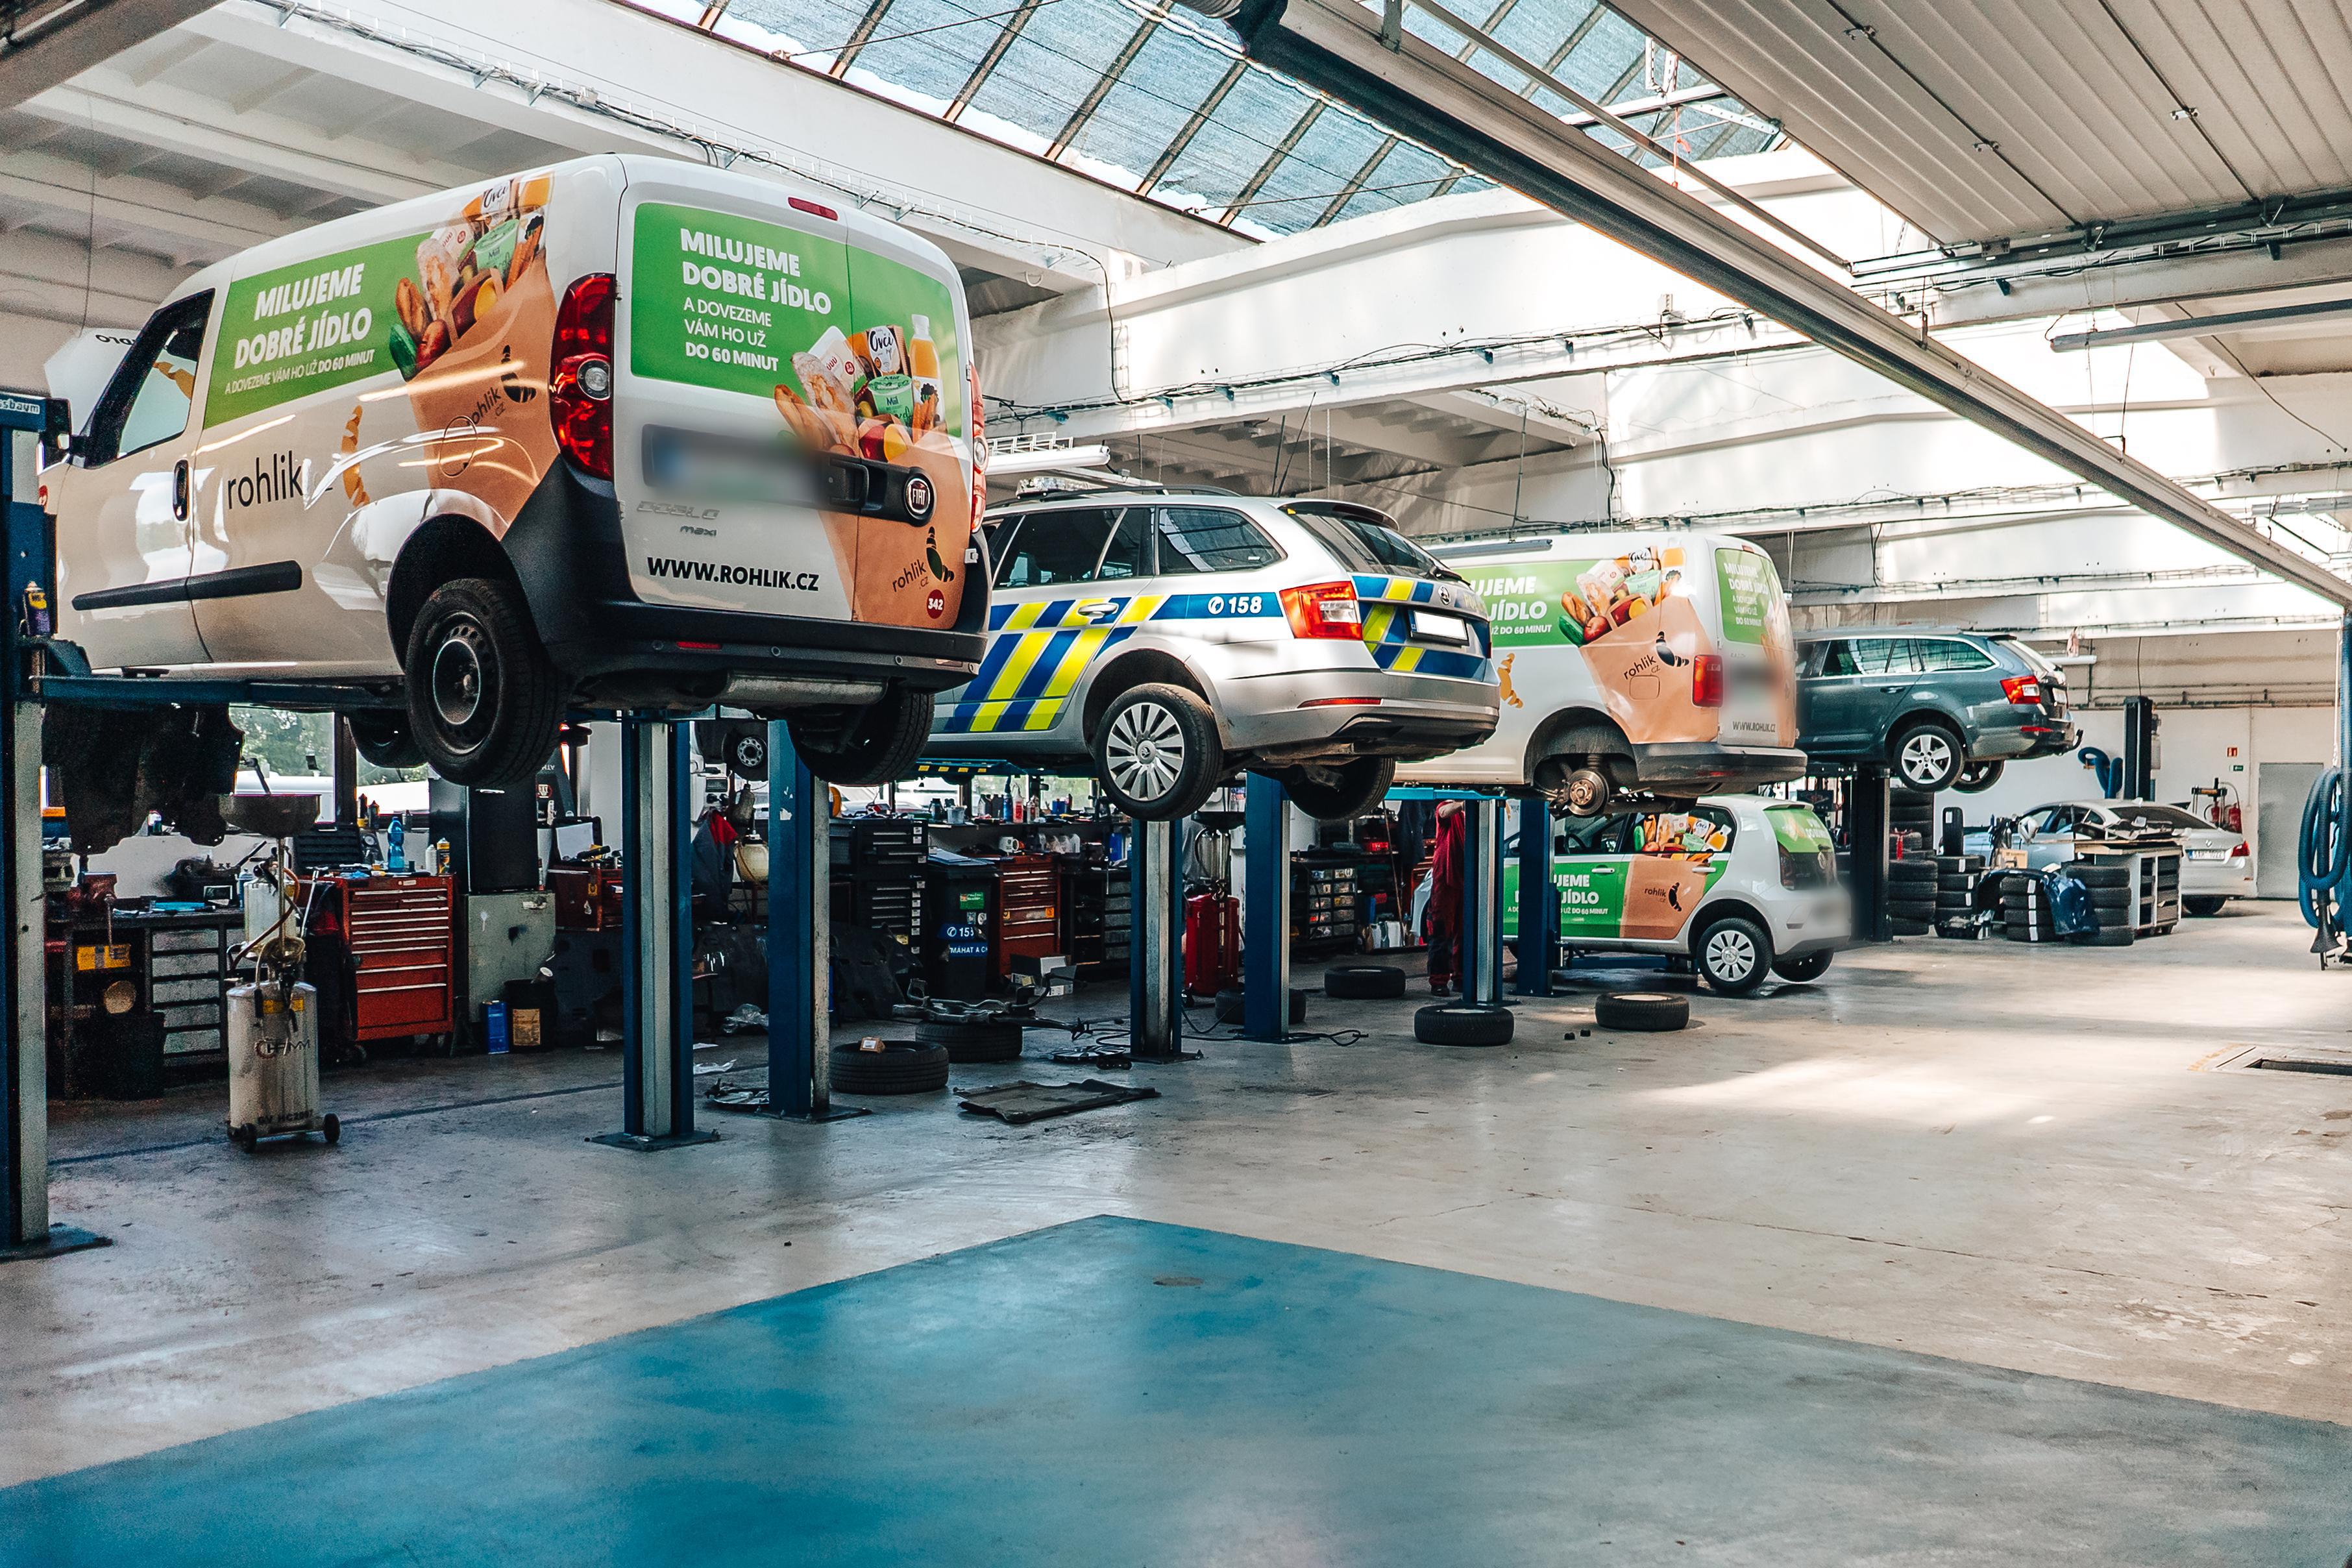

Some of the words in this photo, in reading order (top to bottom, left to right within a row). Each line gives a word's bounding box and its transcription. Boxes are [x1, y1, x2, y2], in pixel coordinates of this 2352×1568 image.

[681, 228, 800, 277] MILUJEME
[254, 263, 365, 321] MILUJEME
[683, 262, 766, 300] DOBRÉ
[771, 278, 831, 315] JÍDLO
[683, 297, 694, 312] A
[698, 299, 772, 327] DOVEZEME
[234, 315, 306, 369] DOBRÉ
[307, 308, 372, 352] JÍDLO
[684, 318, 718, 339] VÁM
[722, 326, 744, 343] HO
[748, 330, 766, 348] UŽ
[685, 342, 709, 359] DO
[712, 347, 730, 363] 60
[733, 350, 779, 371] MINUT
[225, 382, 231, 395] A
[232, 372, 271, 393] DOVEZEME
[272, 366, 290, 384] VÁM
[291, 365, 304, 379] HO
[306, 359, 317, 376] UŽ
[318, 360, 332, 374] DO
[332, 356, 344, 371] 60
[345, 349, 374, 367] MINUT
[228, 450, 304, 509] rohlik
[637, 500, 720, 520] DOBLO
[913, 488, 926, 505] FIAT
[647, 557, 820, 591] WWW.ROHLIK.CZ
[892, 559, 927, 593] rohlik
[928, 598, 944, 610] 342
[1229, 596, 1262, 614] 158
[1489, 599, 1548, 621] JÍDLO
[1500, 626, 1512, 635] DO
[1514, 626, 1524, 635] 60
[1525, 624, 1552, 633] MINUT
[1623, 654, 1657, 680] rohlik
[1562, 888, 1599, 905] JÍDLO
[1645, 887, 1667, 898] rohlik
